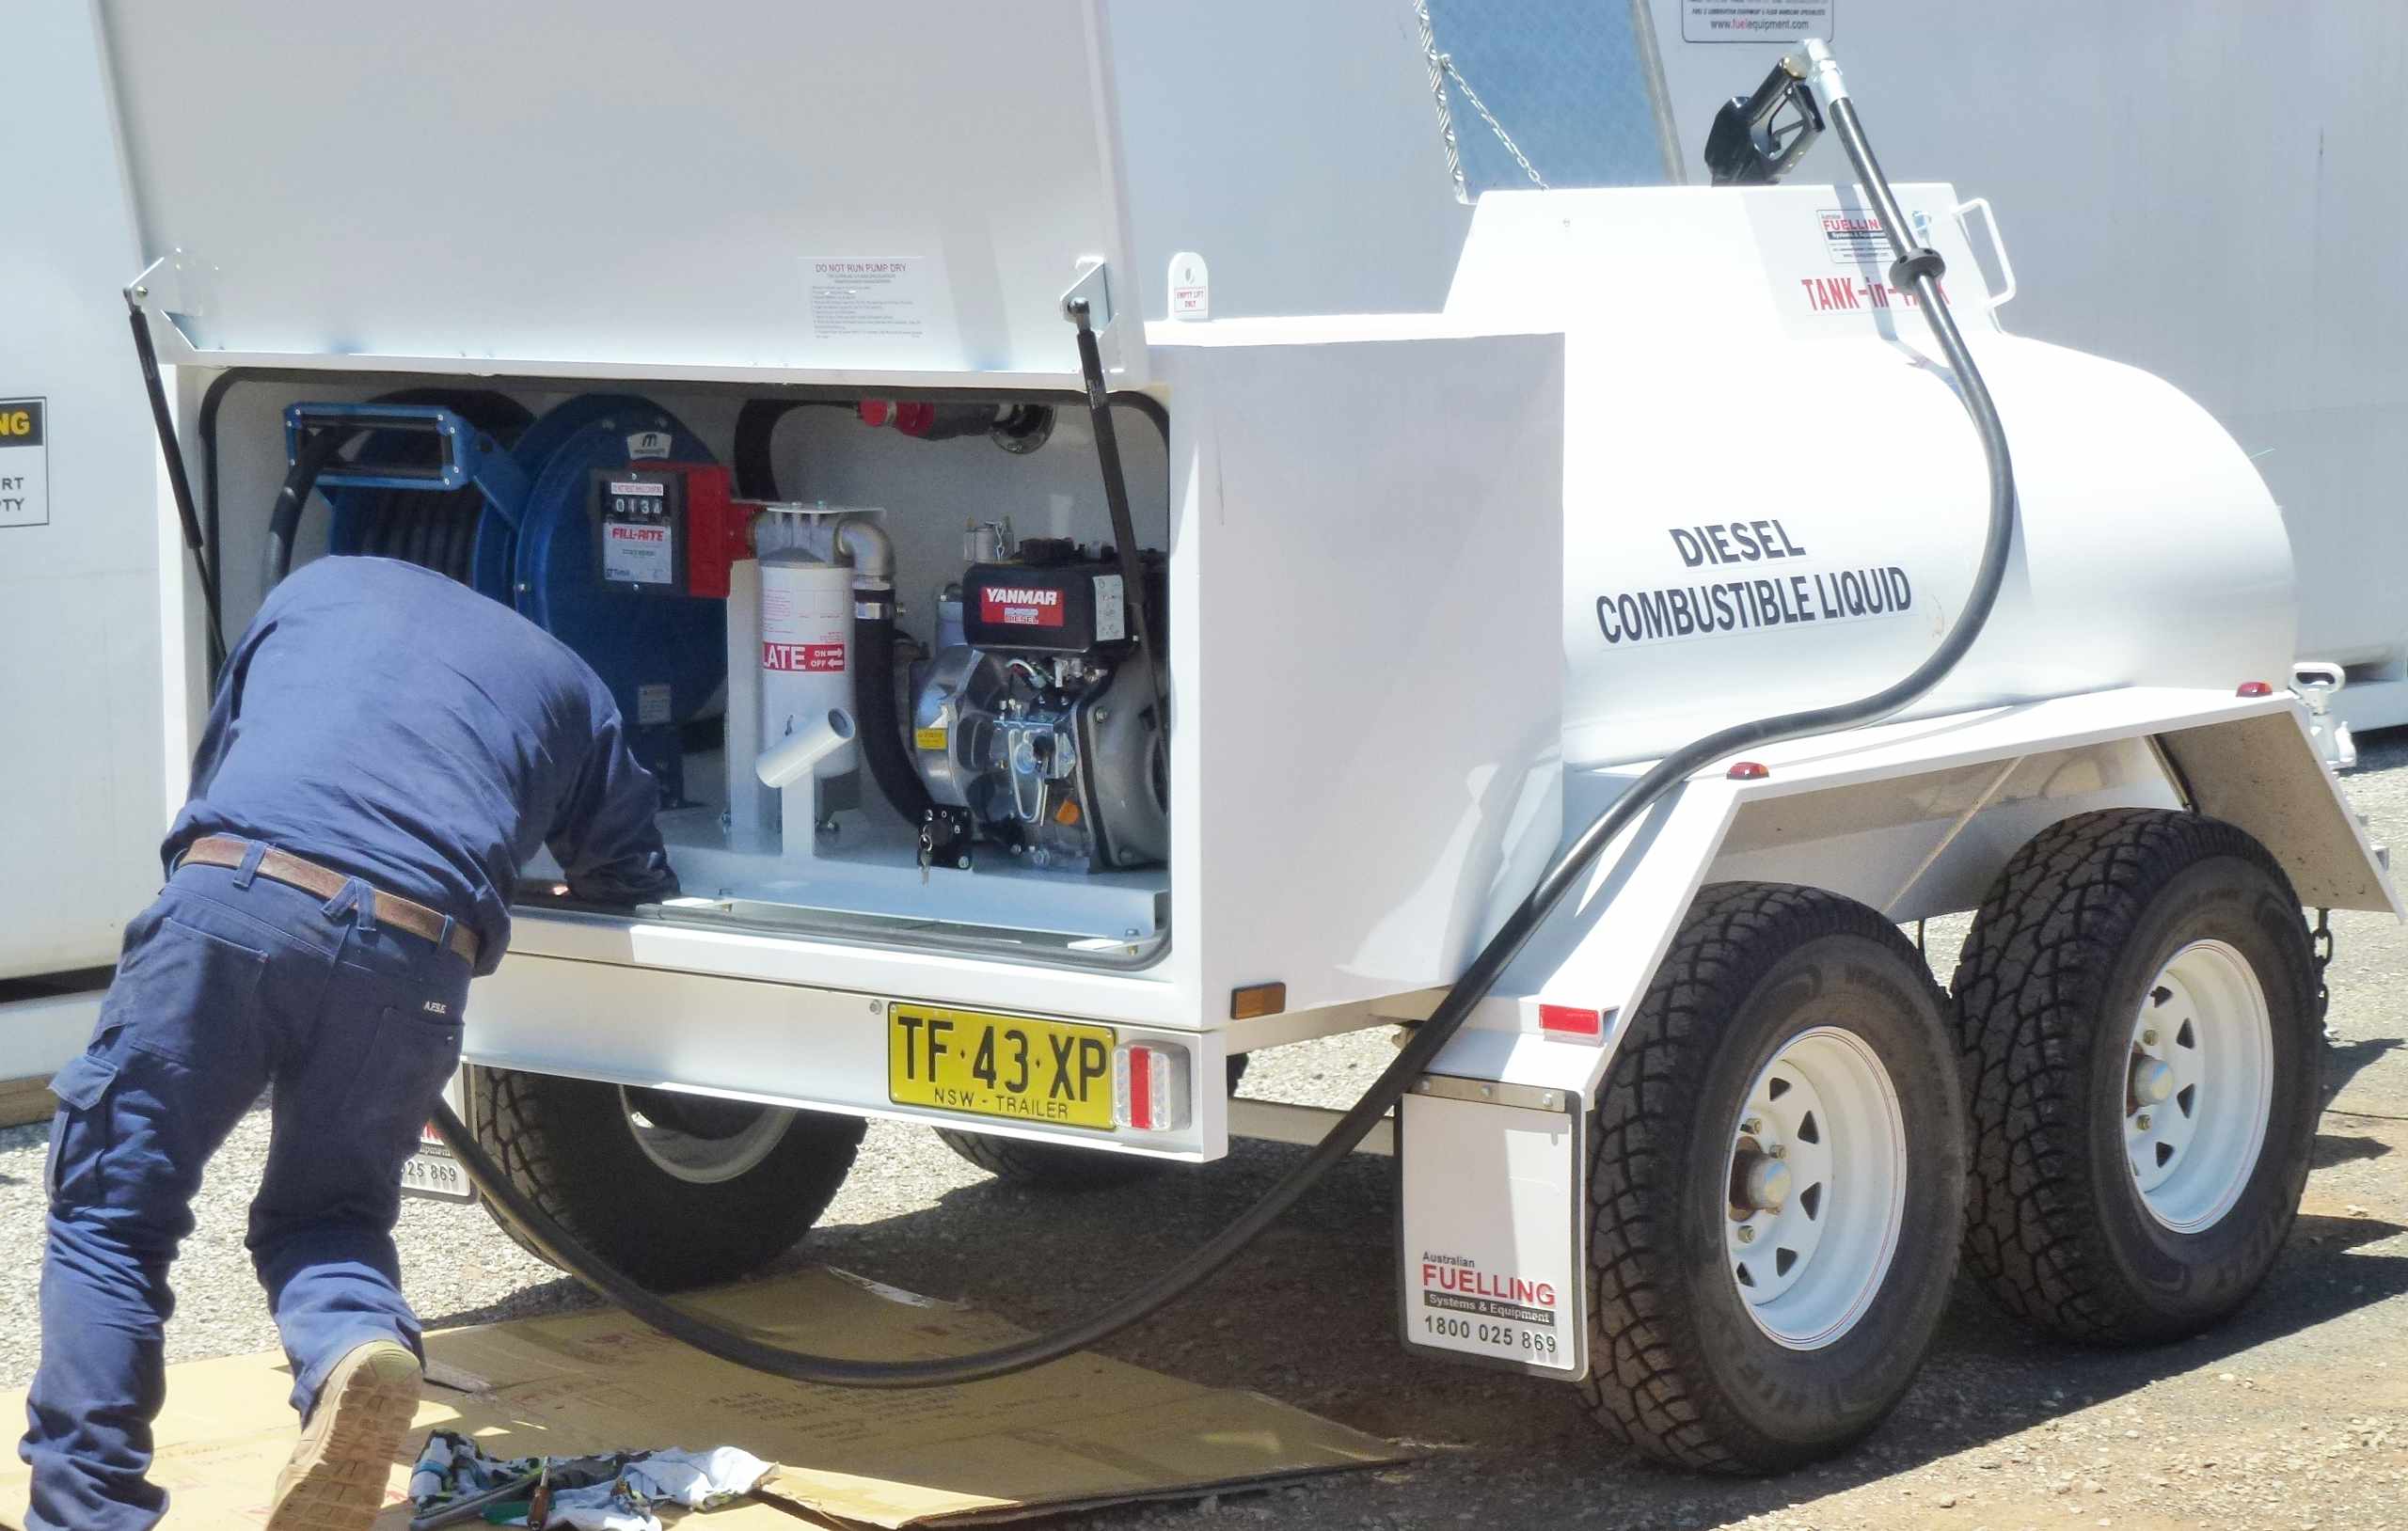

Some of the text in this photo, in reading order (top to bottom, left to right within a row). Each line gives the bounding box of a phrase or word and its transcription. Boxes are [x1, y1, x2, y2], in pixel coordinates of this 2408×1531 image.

[1710, 19, 1809, 31] www.fuelequipment.com
[1822, 218, 1883, 231] FUELLIN
[816, 263, 907, 273] DO NOT RUN PUMP DRY
[0, 497, 24, 512] TY
[612, 528, 664, 542] FILL-RITE
[1669, 519, 1807, 568] DIESEL
[986, 588, 1057, 606] YANMAR
[1596, 566, 1912, 644] COMBUSTIBLE LIQUID
[811, 659, 826, 668] OFF
[934, 1087, 974, 1108] NSW
[995, 1095, 1069, 1120] TRAILER
[430, 1164, 457, 1182] 869
[1422, 1251, 1475, 1269] Australian
[1422, 1263, 1557, 1306] FUELLING
[1429, 1293, 1550, 1323] Systems & Equipment
[1424, 1315, 1557, 1354] 1800 025 869
